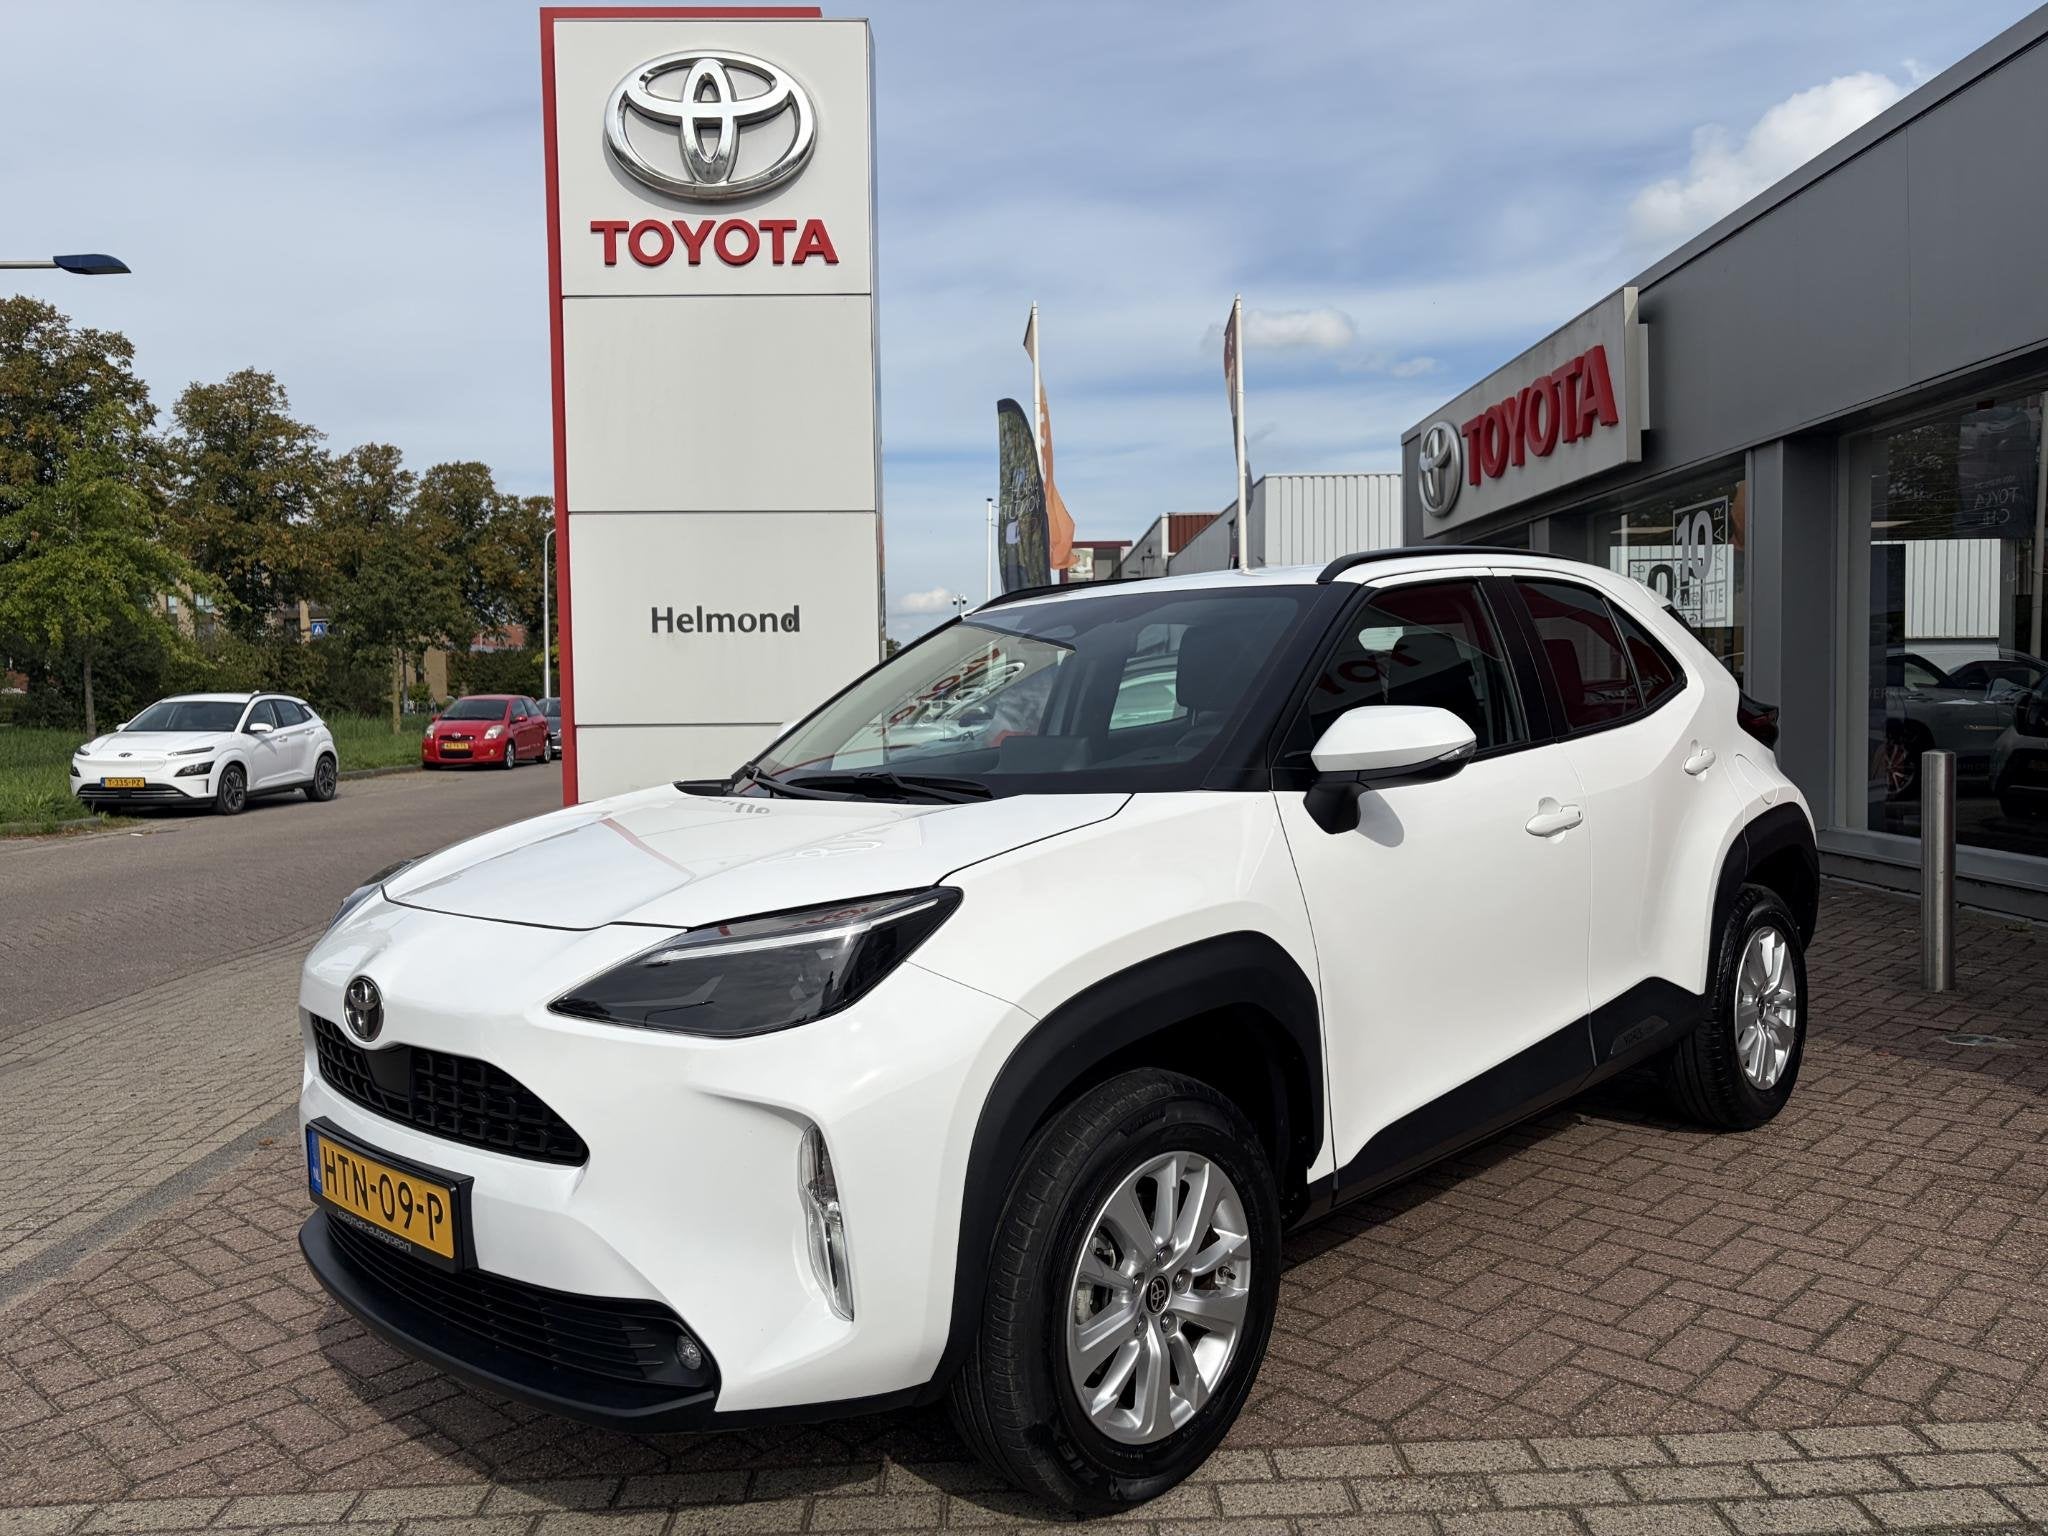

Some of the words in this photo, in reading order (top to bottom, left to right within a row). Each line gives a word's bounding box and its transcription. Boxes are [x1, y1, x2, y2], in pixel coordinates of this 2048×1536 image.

[591, 219, 839, 266] TOYOTA
[1461, 344, 1619, 486] TOYOTA
[1676, 510, 1713, 583] 10
[651, 604, 801, 633] Helmond
[323, 1146, 444, 1242] HTN-09-P
